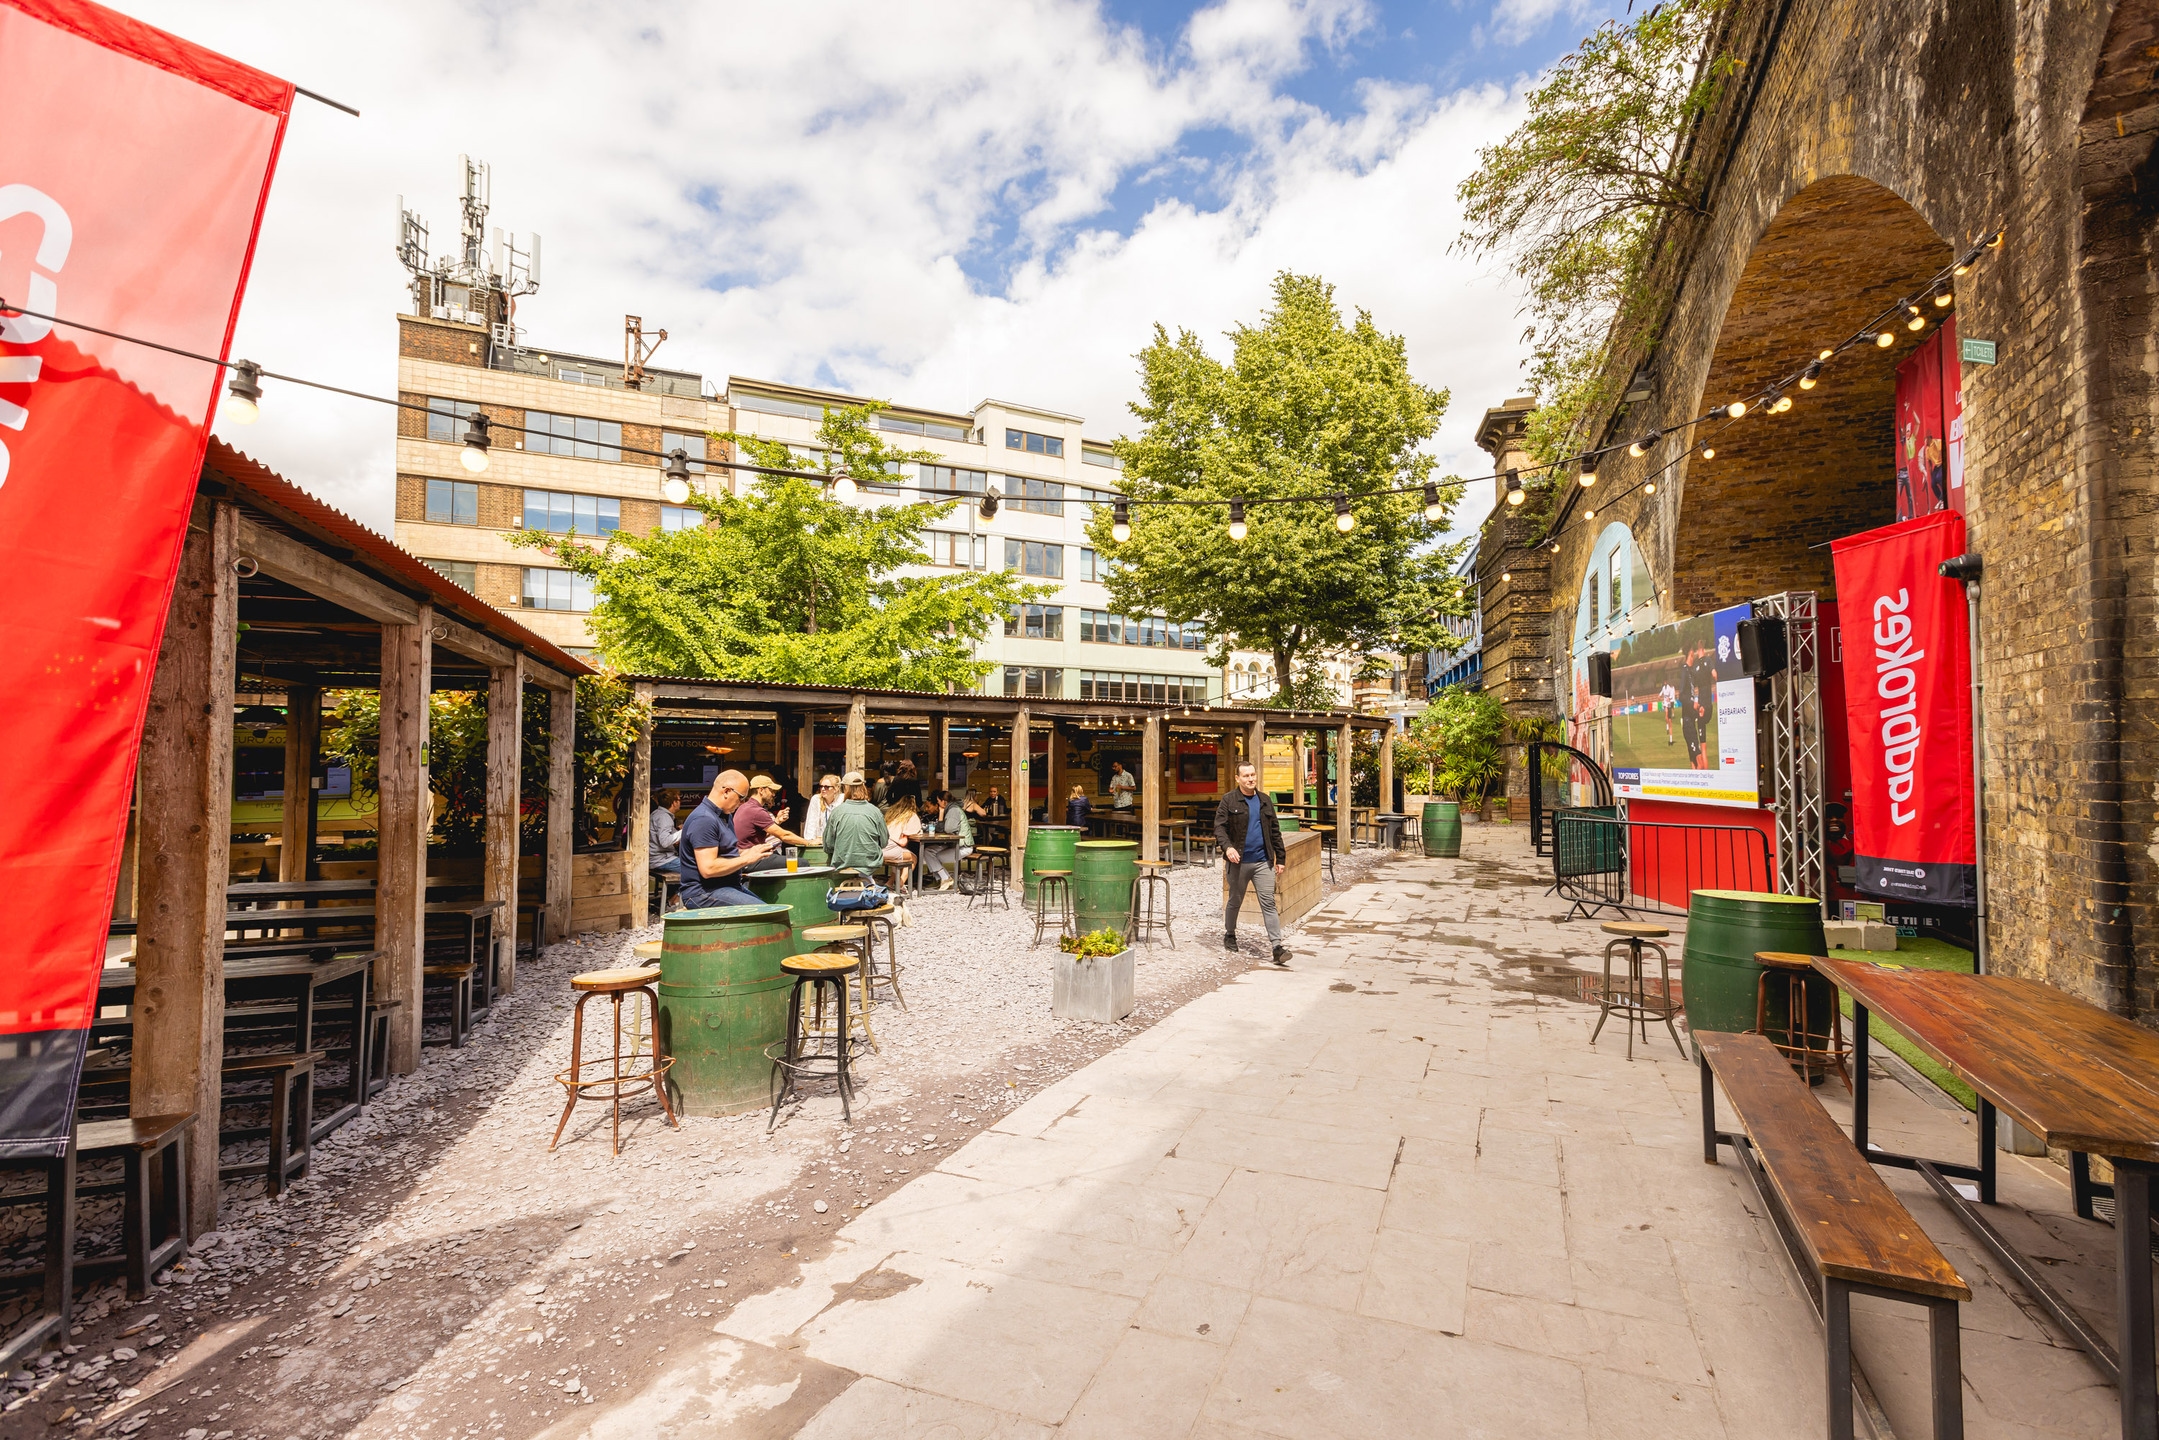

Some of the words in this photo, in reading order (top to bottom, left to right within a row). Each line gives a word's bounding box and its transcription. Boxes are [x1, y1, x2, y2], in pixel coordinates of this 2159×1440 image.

[1973, 344, 1994, 359] TOILETS
[1719, 707, 1747, 716] BARBARIANS
[268, 736, 286, 744] 202
